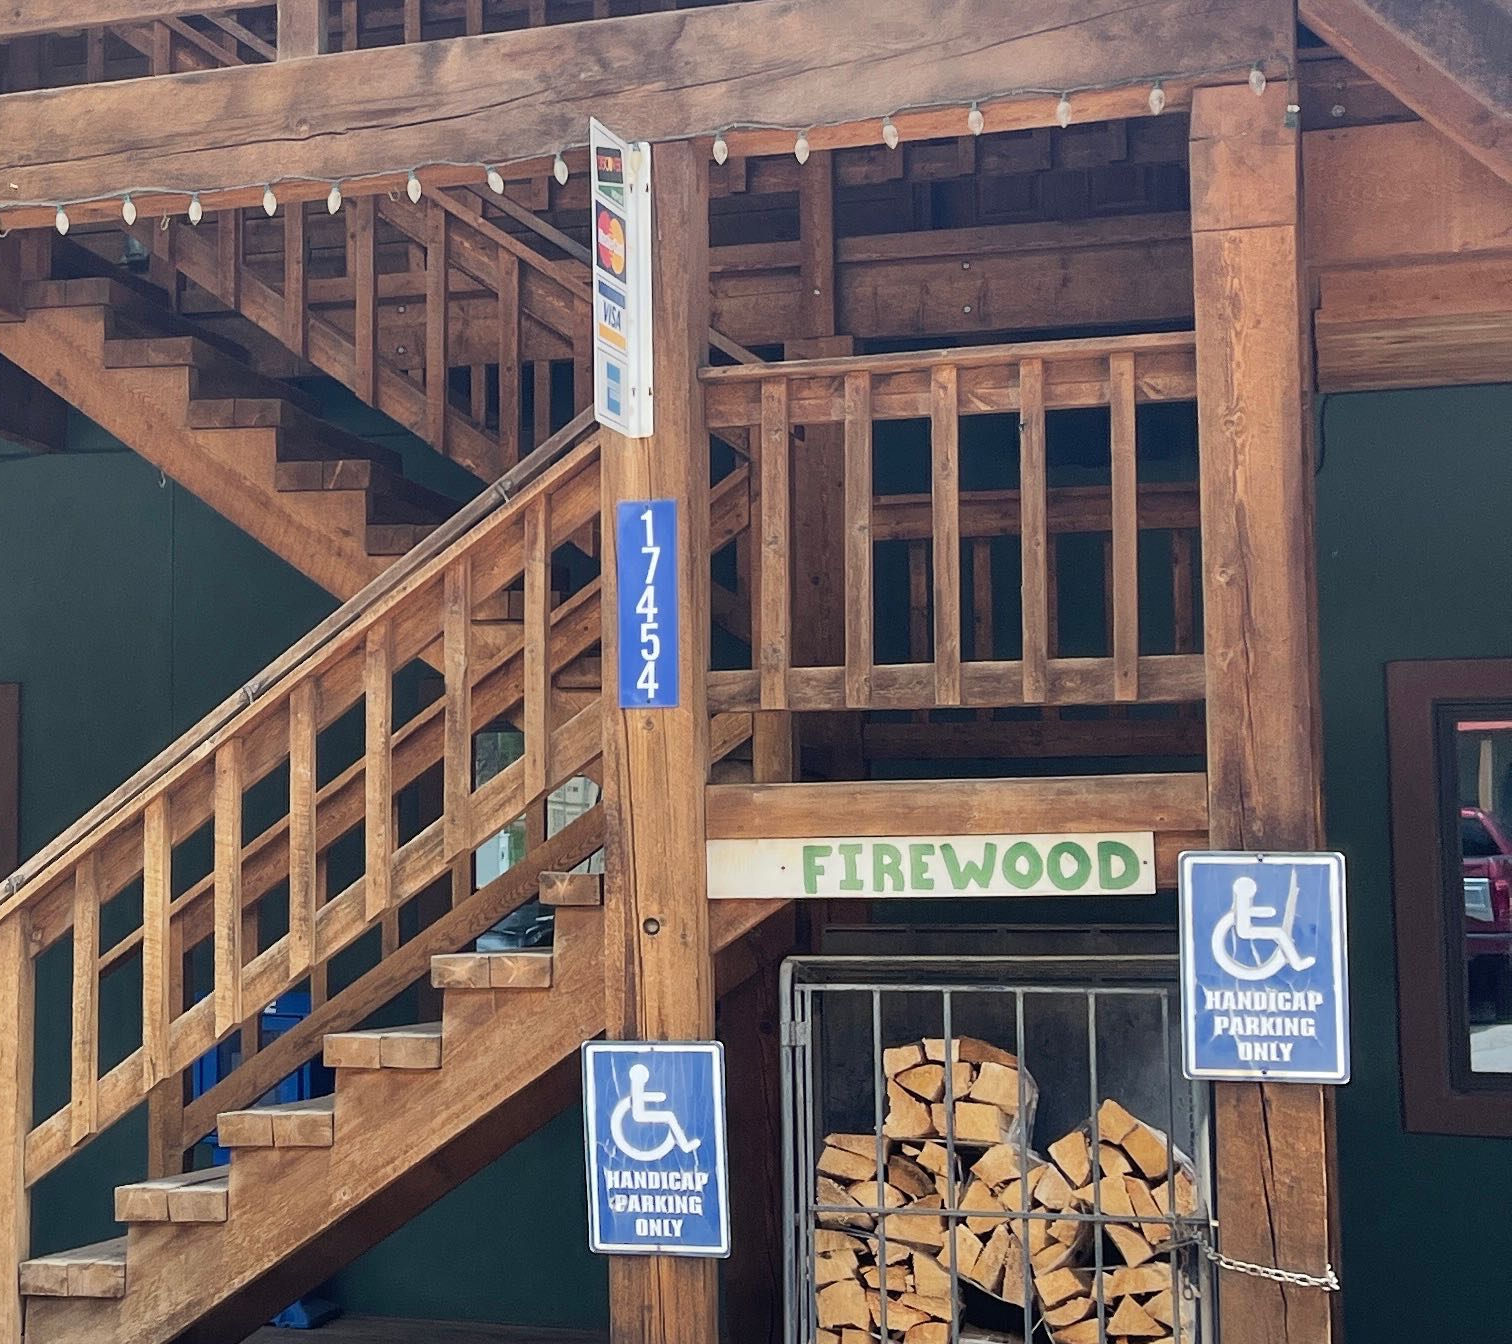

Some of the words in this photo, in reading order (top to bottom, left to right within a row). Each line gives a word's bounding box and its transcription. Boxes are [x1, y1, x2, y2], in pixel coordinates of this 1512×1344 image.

[603, 301, 621, 331] VISA
[636, 509, 661, 699] 17454
[802, 841, 1141, 895] FIREWOOD
[1205, 989, 1324, 1013] HANDICAP
[1214, 1016, 1317, 1038] PARKING
[1238, 1041, 1294, 1062] ONLY
[605, 1169, 709, 1192] HANDICAP
[613, 1194, 704, 1216] PARKING
[634, 1218, 683, 1238] ONLY
